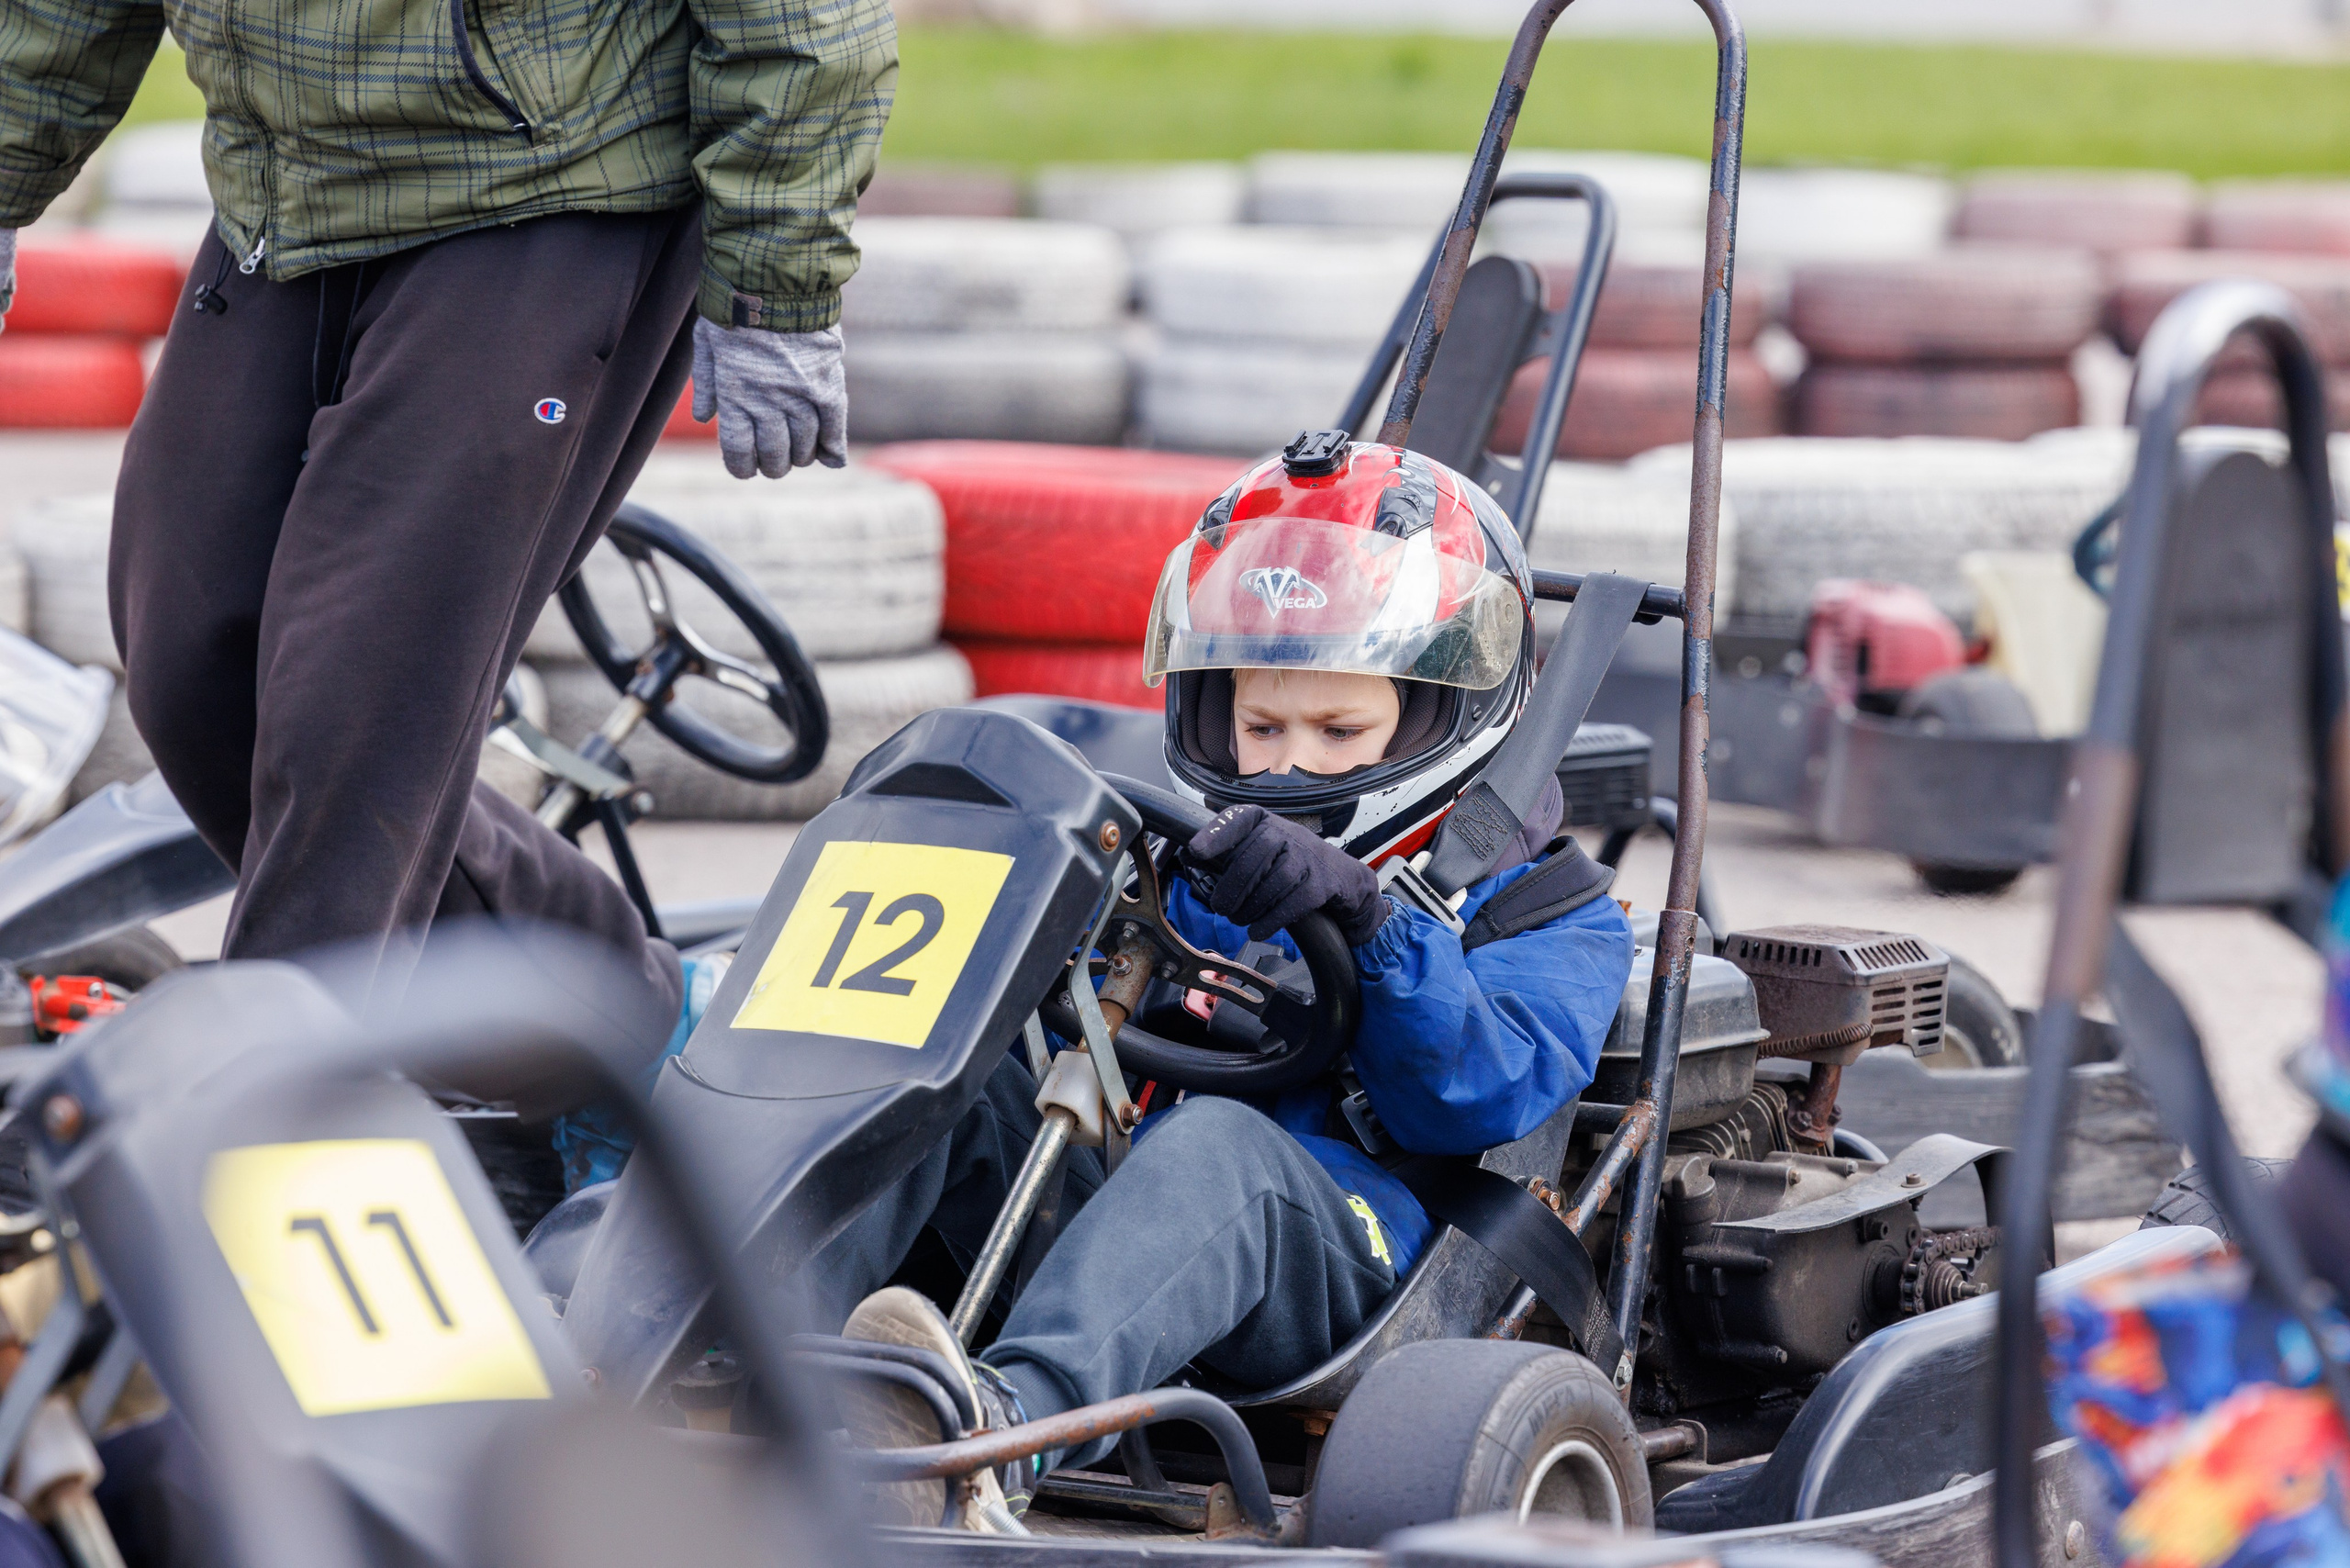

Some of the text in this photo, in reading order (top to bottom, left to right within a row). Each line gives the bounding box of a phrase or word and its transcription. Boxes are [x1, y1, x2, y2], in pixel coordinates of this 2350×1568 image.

[1273, 597, 1317, 610] VEGA
[810, 890, 946, 997] 12
[290, 1210, 454, 1336] 11
